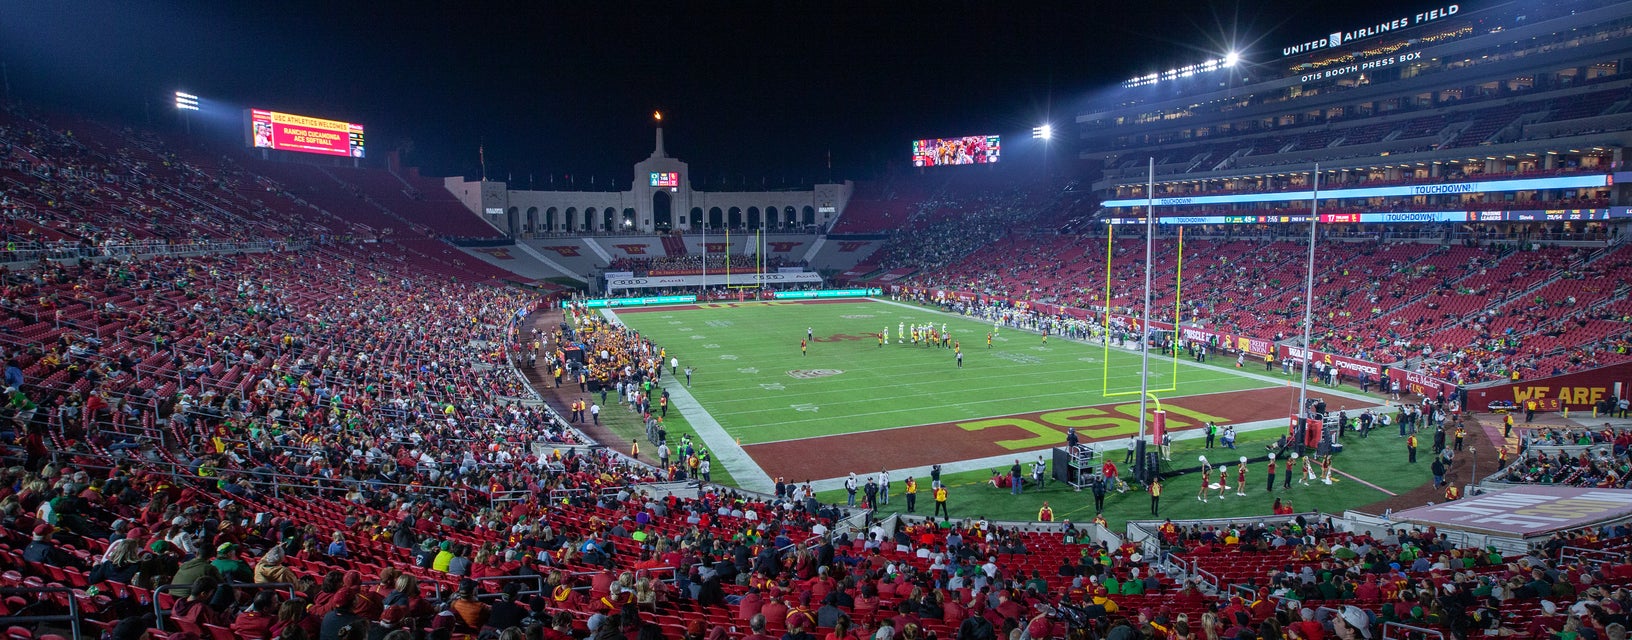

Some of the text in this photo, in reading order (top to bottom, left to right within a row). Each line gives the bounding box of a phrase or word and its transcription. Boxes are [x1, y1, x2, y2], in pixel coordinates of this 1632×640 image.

[1283, 4, 1459, 56] UNITED AIRLINES FIELD
[1301, 51, 1422, 82] OTIS BOOTH PRESS BOX
[273, 114, 286, 122] USC
[287, 116, 317, 127] ATHLETICS
[318, 119, 348, 131] WELCOMES
[283, 127, 307, 136] RANCHO
[308, 130, 341, 140] CUCAMONGA
[306, 137, 333, 146] SOFTBALL
[1415, 184, 1471, 194] TOUCHDOWN!
[1327, 214, 1335, 222] 17
[1335, 360, 1378, 375] POWERADE
[1513, 387, 1606, 404] WE ARE
